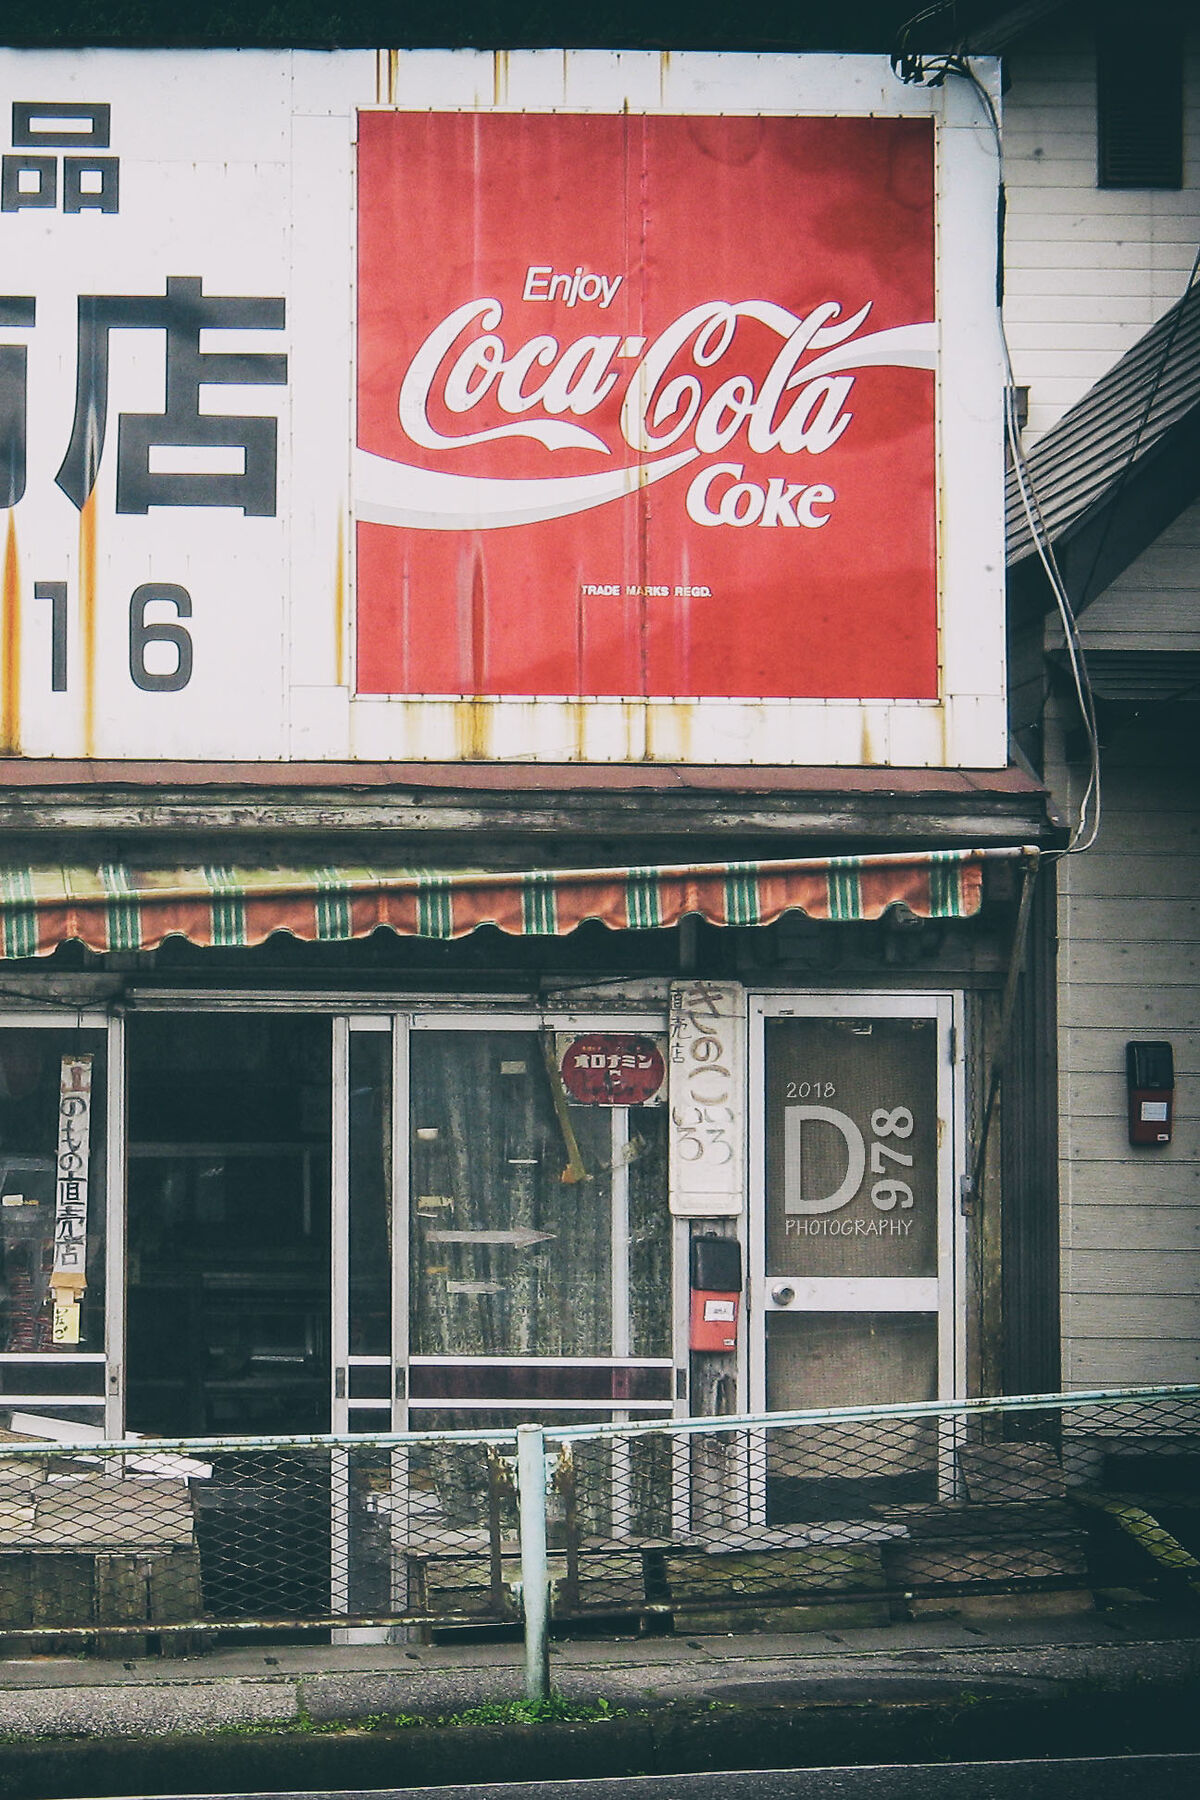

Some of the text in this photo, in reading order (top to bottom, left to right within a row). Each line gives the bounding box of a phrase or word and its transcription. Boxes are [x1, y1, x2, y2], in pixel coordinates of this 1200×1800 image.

[523, 266, 621, 308] Enjoy
[686, 462, 835, 528] Coke
[581, 585, 712, 597] TRADE MARKS REGD.
[574, 1054, 652, 1069] オロナミン
